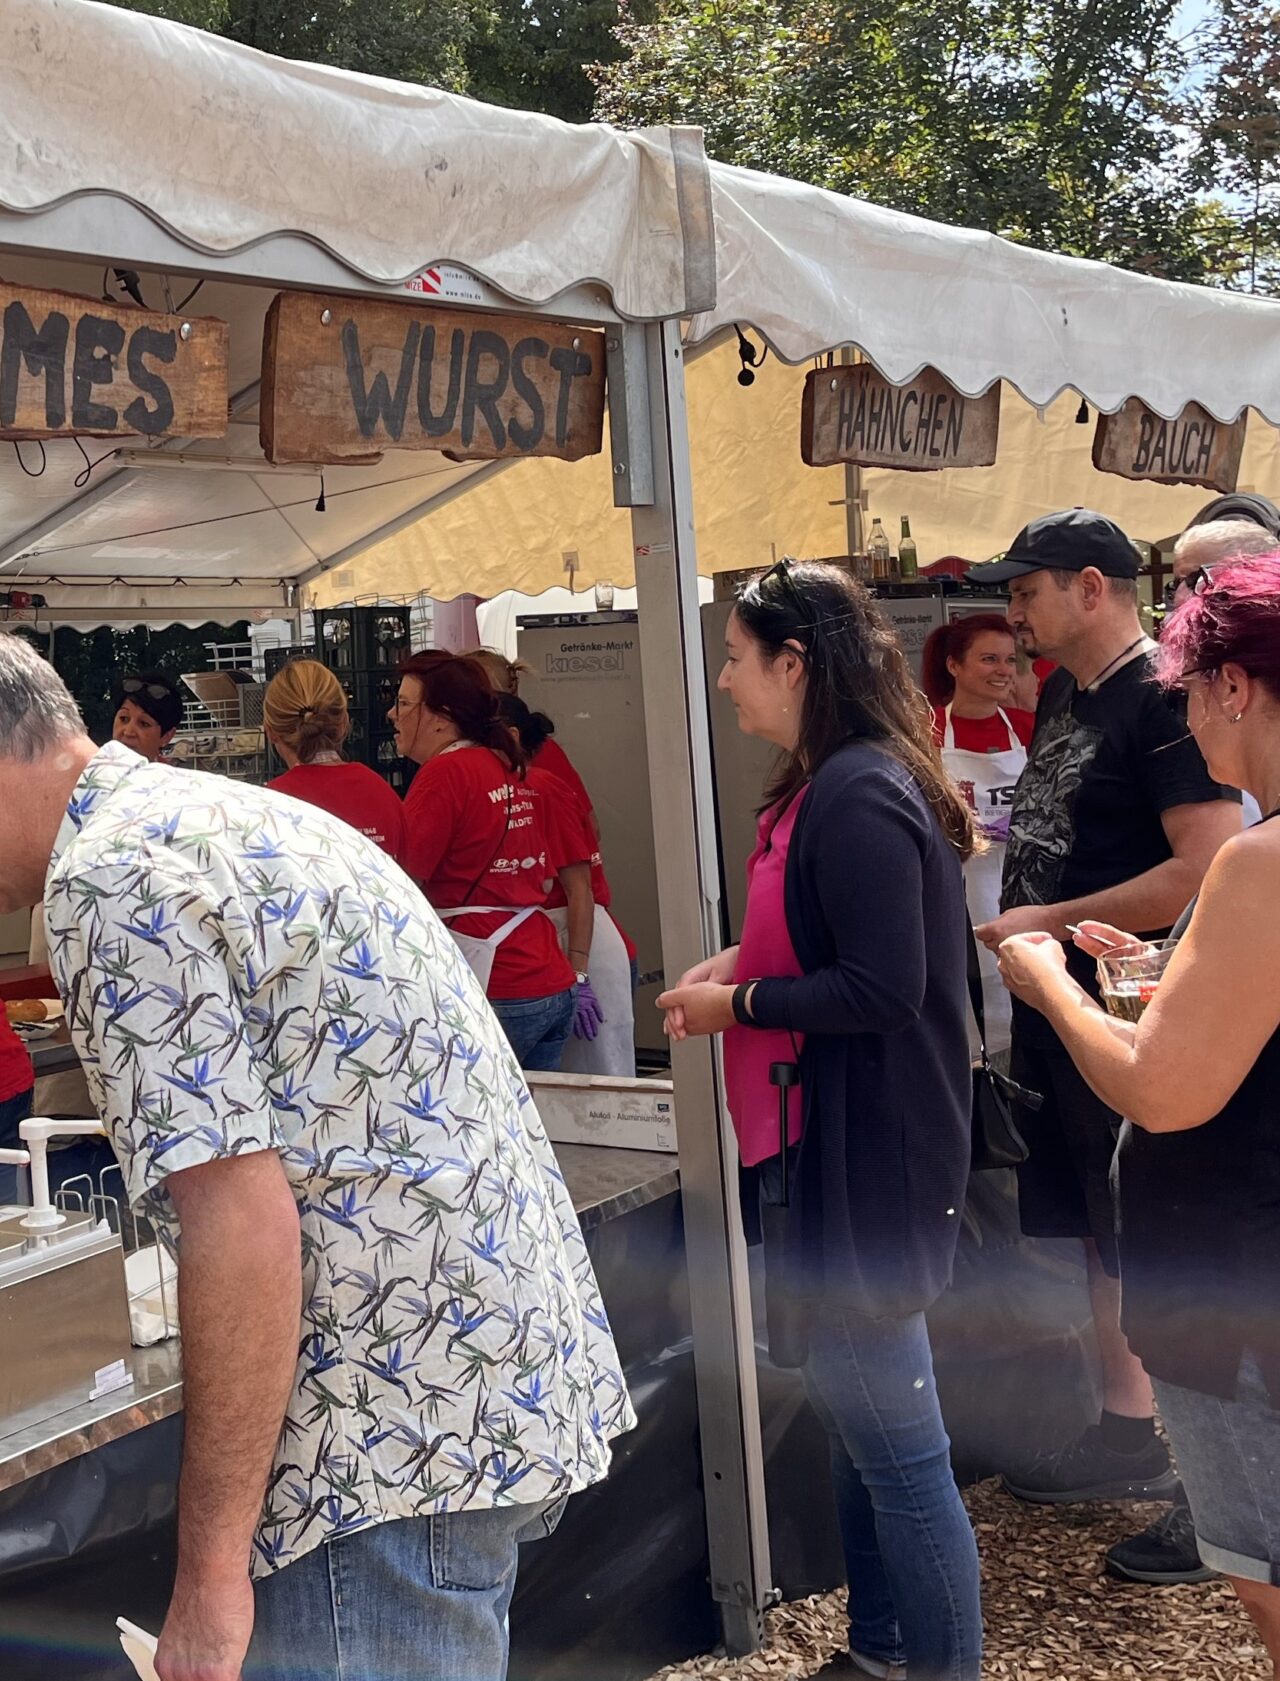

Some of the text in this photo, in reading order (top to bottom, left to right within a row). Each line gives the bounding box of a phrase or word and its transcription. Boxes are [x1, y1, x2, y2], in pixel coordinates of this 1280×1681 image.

[341, 317, 593, 451] WURST
[836, 371, 965, 459] HÄHNCHEN
[1132, 413, 1216, 475] BAUCH
[545, 651, 625, 673] kiesel
[560, 641, 634, 653] Getränke-Markt
[986, 785, 1016, 806] TS
